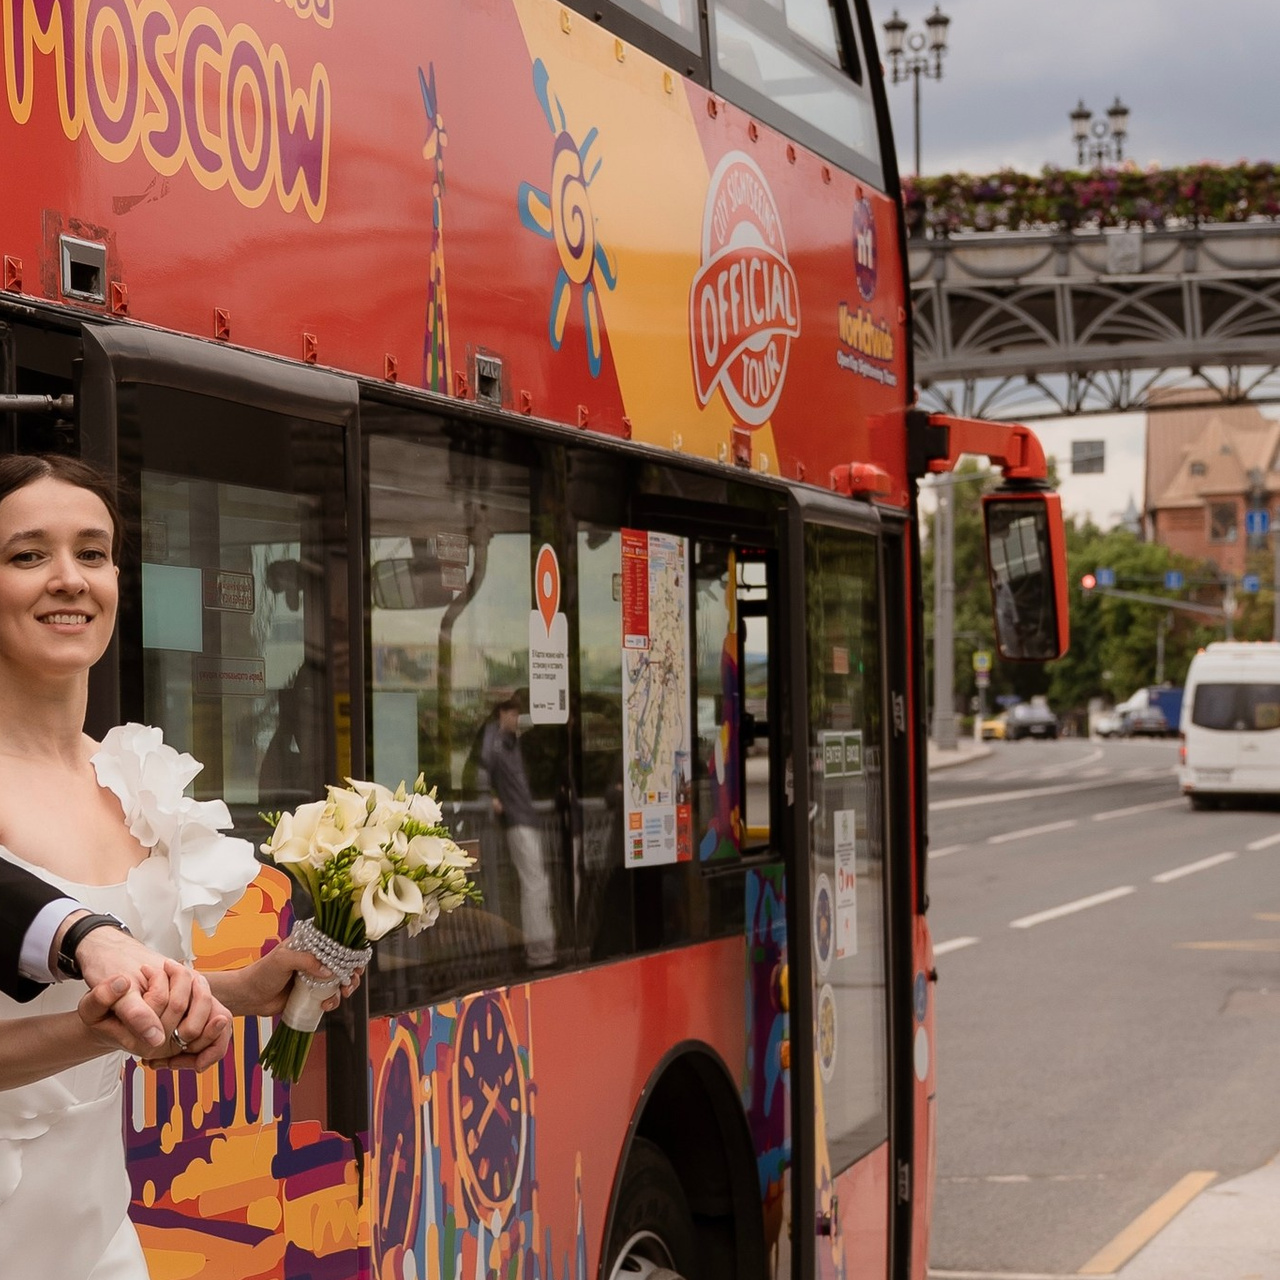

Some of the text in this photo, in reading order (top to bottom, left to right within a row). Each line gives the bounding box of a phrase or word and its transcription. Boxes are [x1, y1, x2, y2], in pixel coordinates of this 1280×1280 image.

[713, 196, 730, 246] CITY
[726, 169, 778, 246] SIGHTSEEING
[700, 256, 797, 368] OFFICIAL
[838, 302, 894, 362] Worldwide
[741, 340, 781, 405] TOUR
